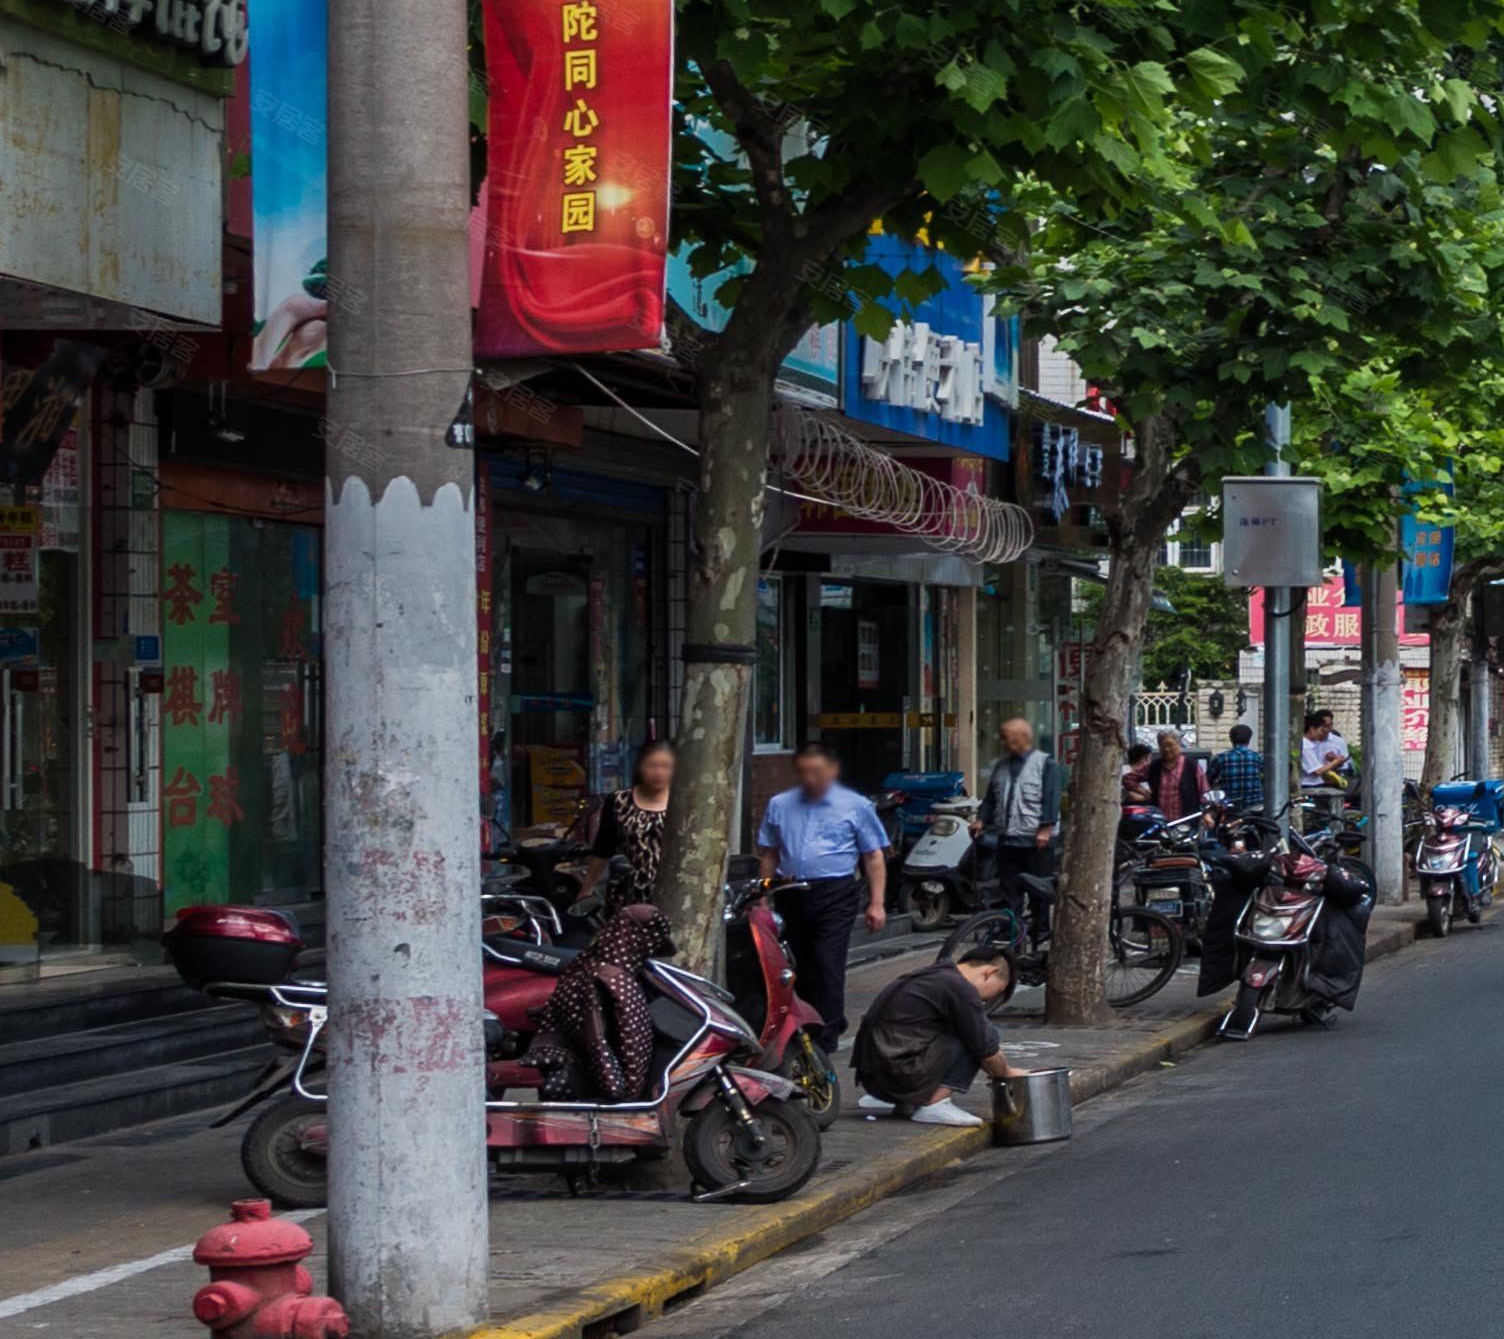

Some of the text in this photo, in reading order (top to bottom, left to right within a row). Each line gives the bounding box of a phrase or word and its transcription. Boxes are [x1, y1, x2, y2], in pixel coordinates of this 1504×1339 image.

[164, 564, 240, 625] 茶室
[163, 665, 243, 725] 棋牌
[164, 765, 244, 827] 台球
